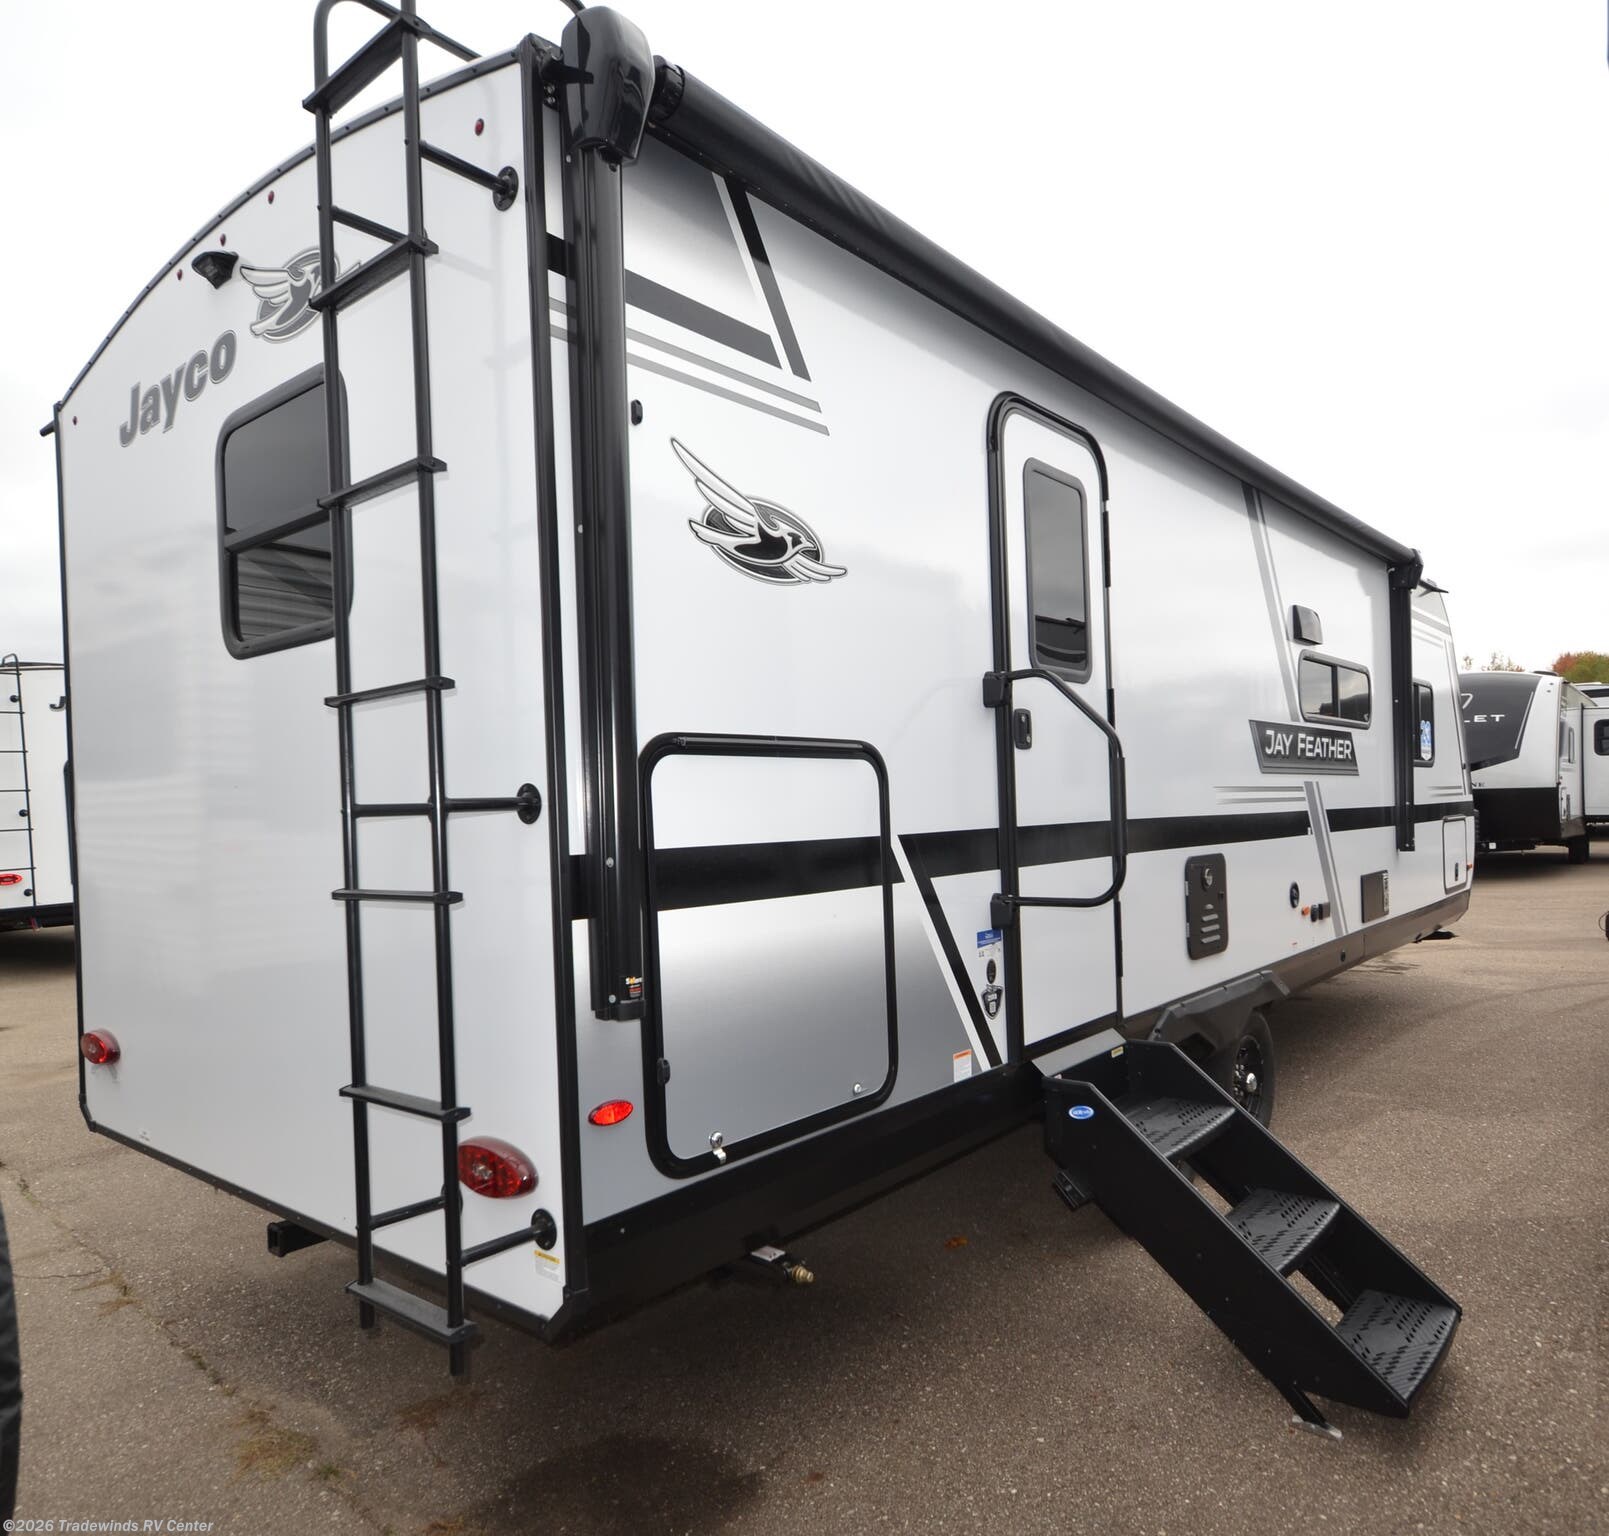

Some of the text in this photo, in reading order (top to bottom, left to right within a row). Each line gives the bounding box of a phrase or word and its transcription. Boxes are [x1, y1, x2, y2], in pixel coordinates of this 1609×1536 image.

[119, 330, 237, 448] Jayco
[1265, 729, 1353, 760] JAY FEATHER
